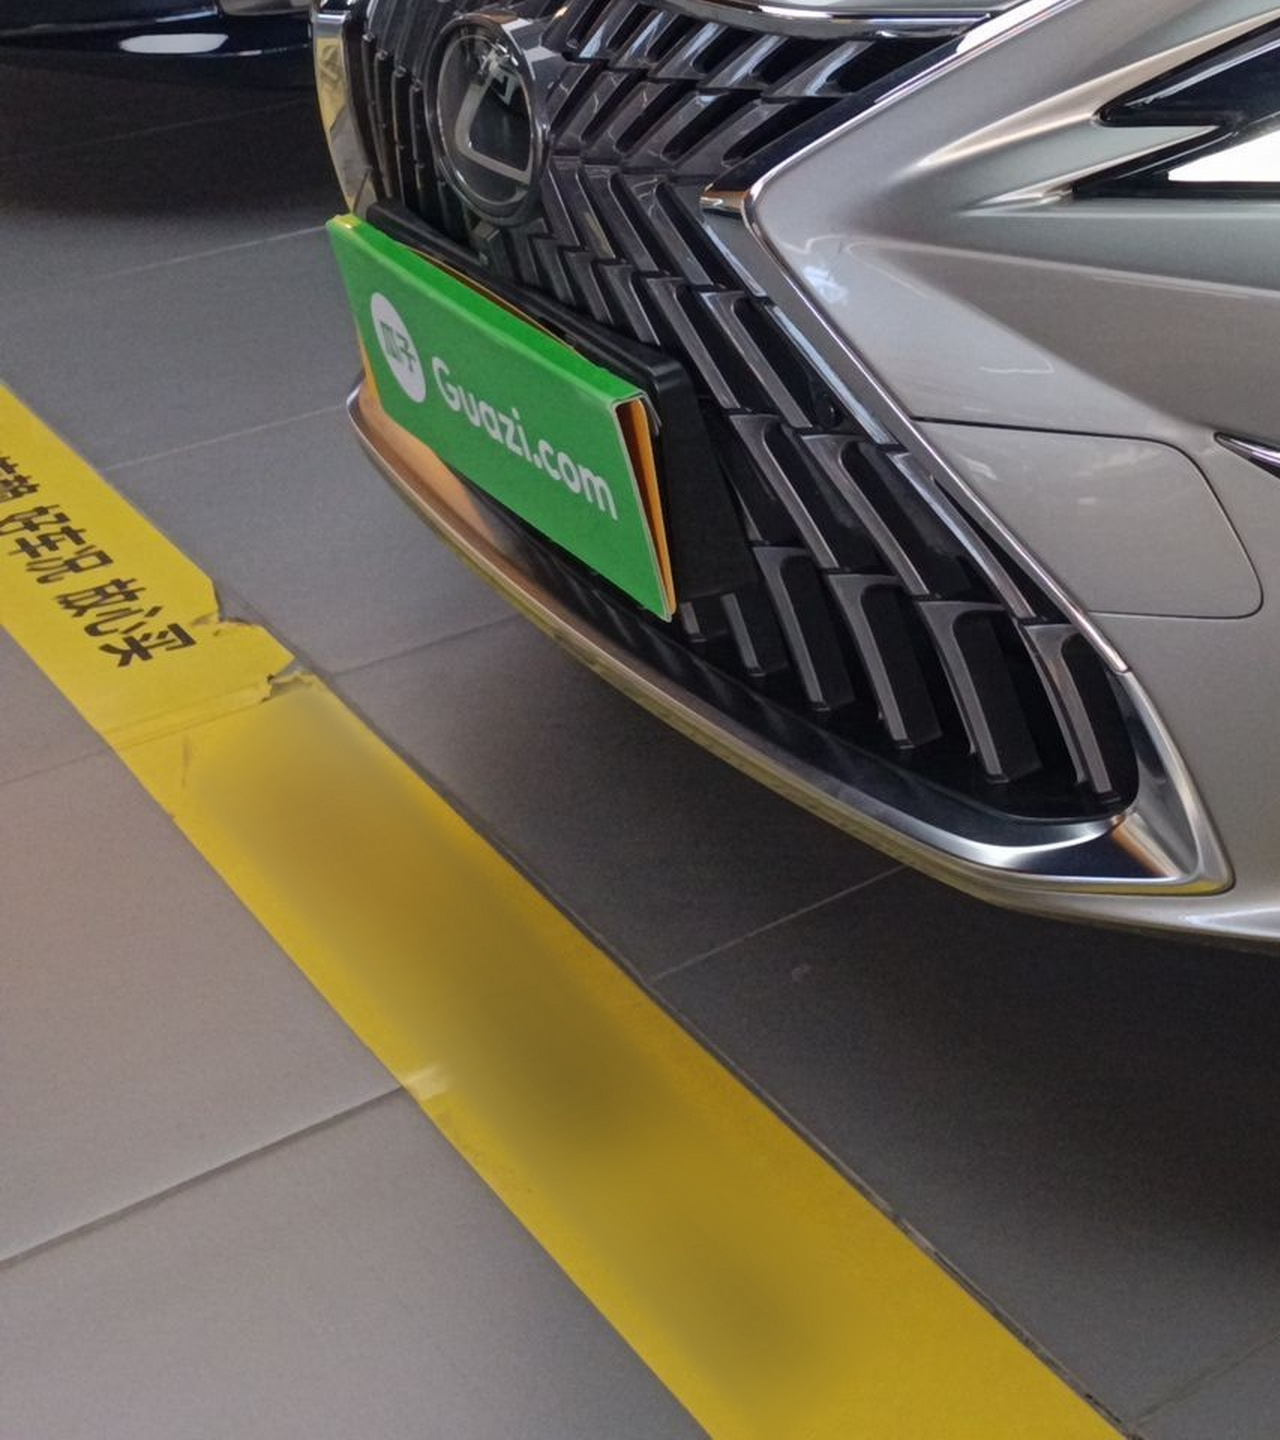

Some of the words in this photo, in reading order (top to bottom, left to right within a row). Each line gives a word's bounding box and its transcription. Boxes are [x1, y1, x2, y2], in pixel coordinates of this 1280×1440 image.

[432, 356, 618, 521] Guazi.com
[0, 504, 114, 584] 好车况
[54, 577, 196, 668] 放心买
